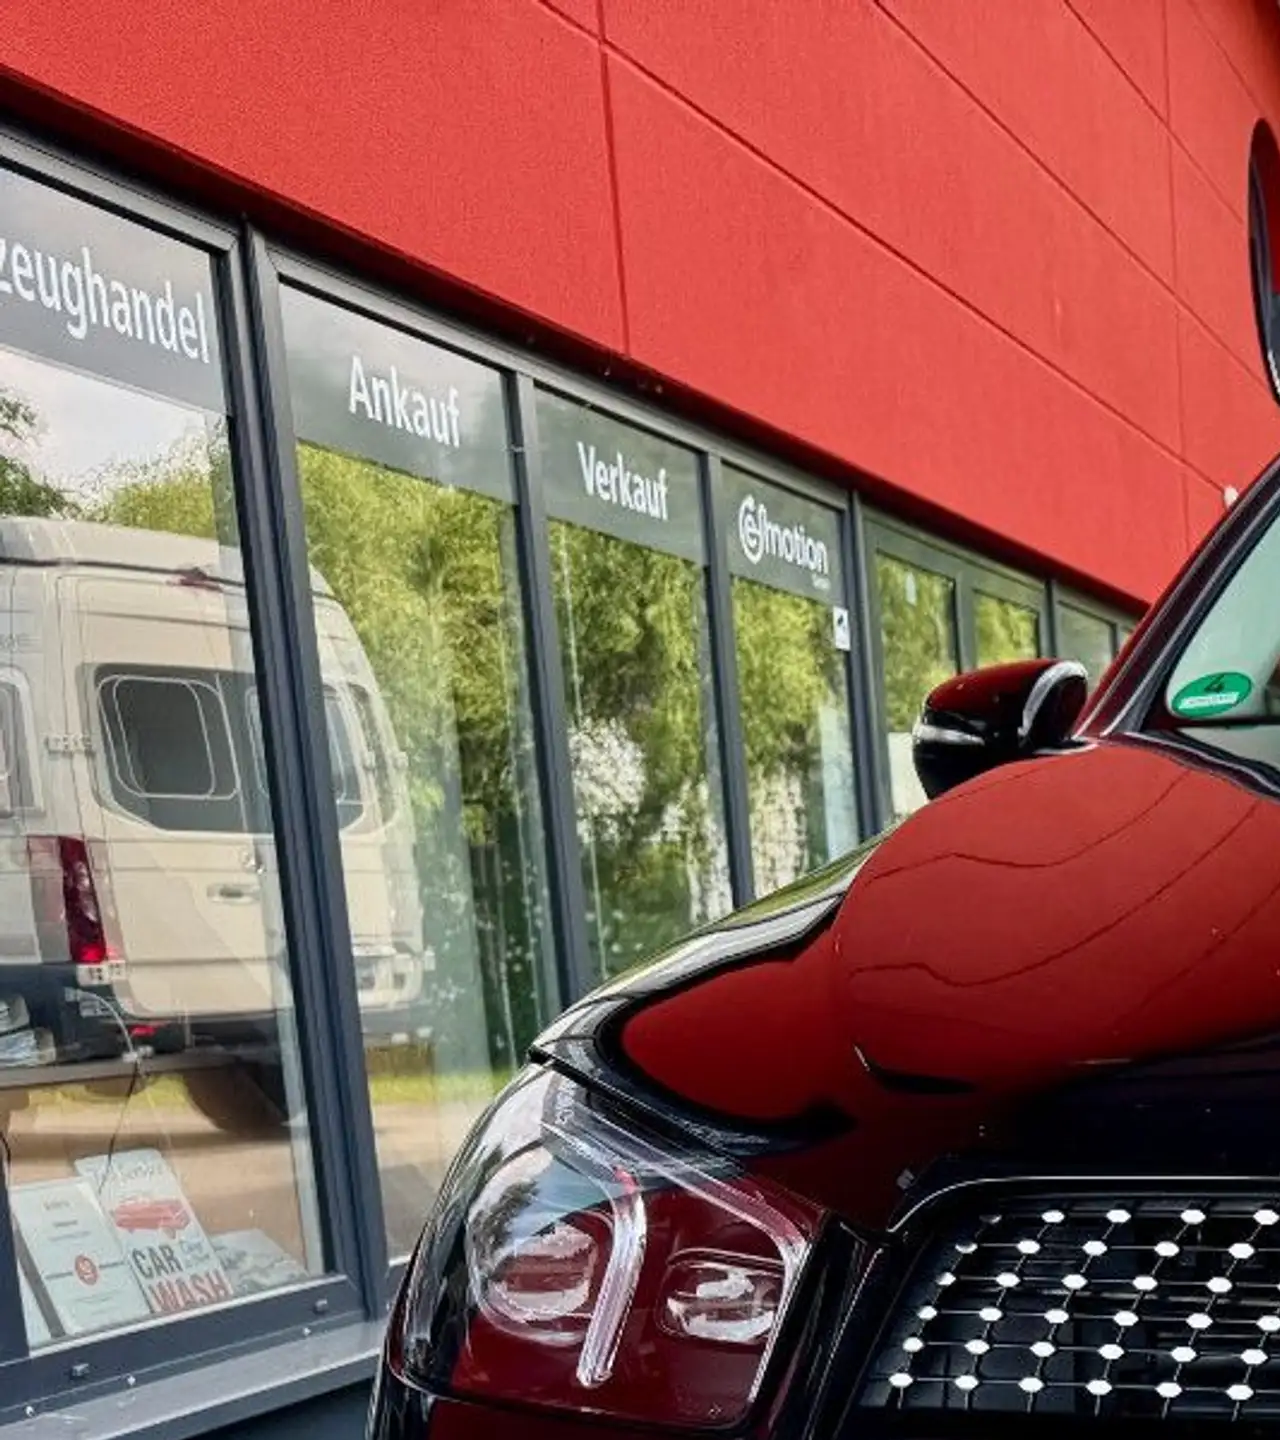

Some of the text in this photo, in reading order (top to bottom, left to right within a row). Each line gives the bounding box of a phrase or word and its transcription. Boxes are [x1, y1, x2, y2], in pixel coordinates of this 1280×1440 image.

[349, 355, 460, 448] Ankauf
[577, 441, 668, 521] Verkauf
[132, 1245, 183, 1279] CAR
[148, 1268, 233, 1314] WASH
